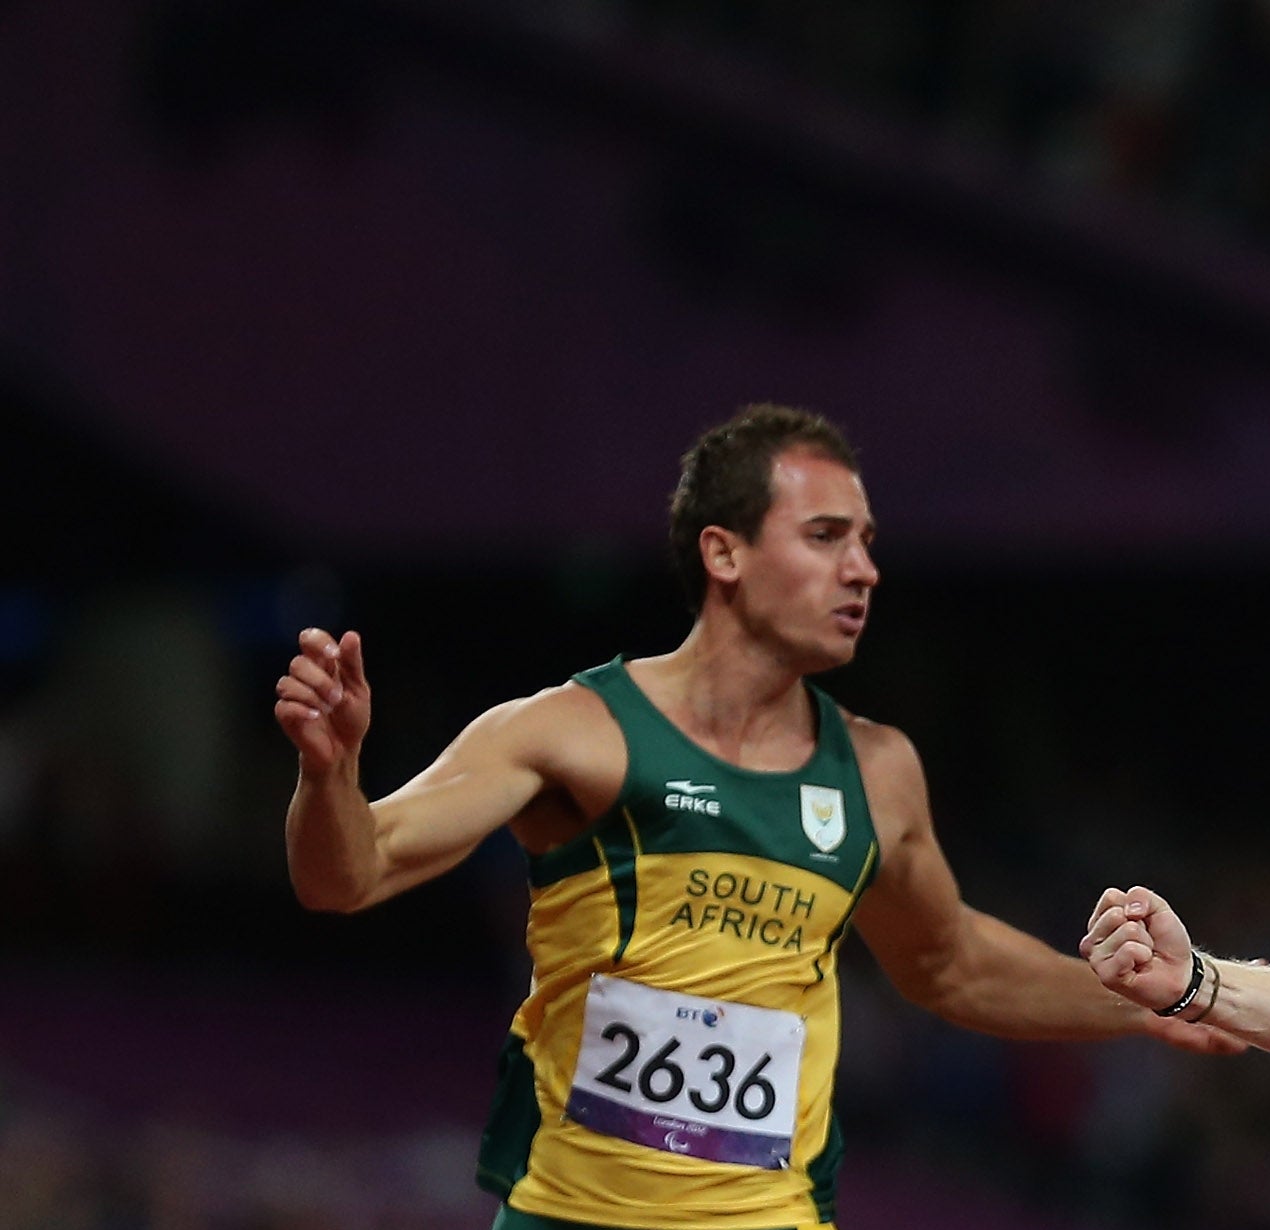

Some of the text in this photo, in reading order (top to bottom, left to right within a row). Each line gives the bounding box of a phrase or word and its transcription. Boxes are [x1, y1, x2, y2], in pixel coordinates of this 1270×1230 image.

[665, 793, 722, 817] ERKE
[686, 869, 816, 919] SOUTH
[669, 902, 803, 951] AFRICA
[676, 1006, 700, 1021] BT
[594, 1021, 776, 1121] 2636
